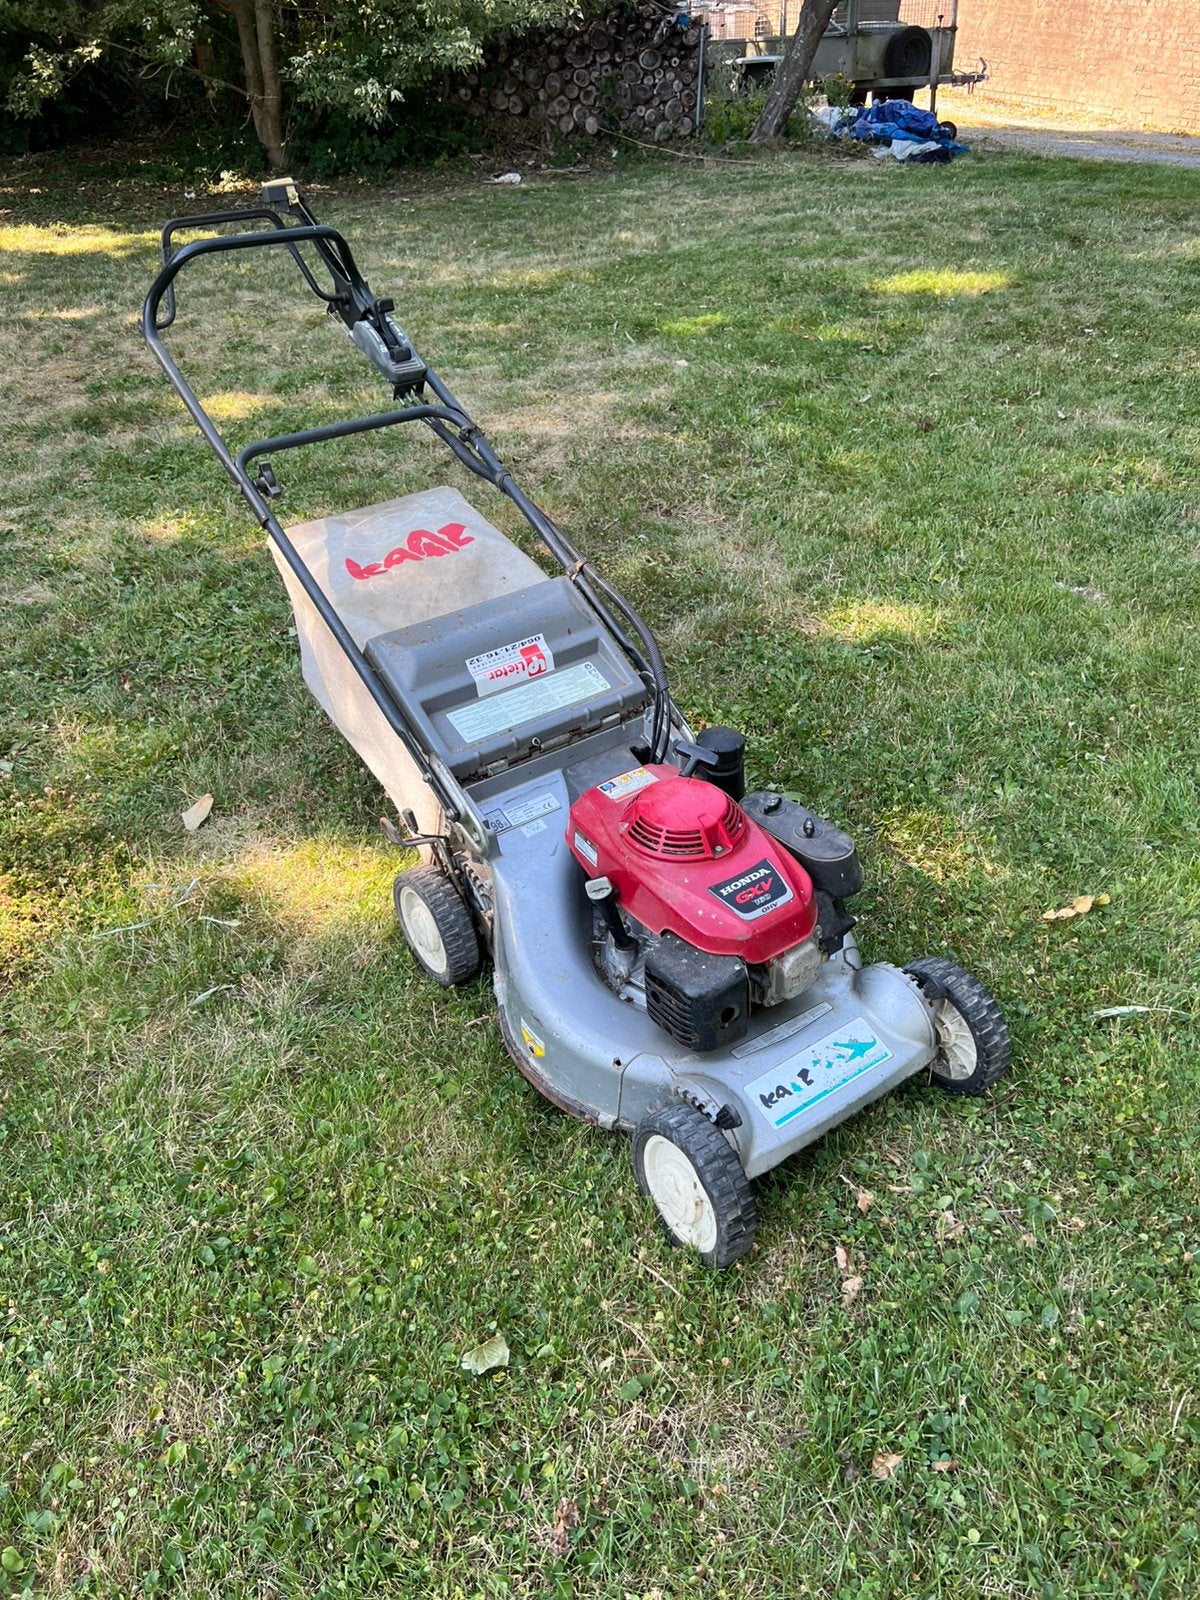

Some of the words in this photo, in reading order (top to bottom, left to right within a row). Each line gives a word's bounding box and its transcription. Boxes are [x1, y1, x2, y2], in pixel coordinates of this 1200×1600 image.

[489, 661, 526, 681] Lietar
[719, 867, 772, 897] HONDA
[735, 877, 774, 905] GXV
[761, 902, 779, 914] OHV
